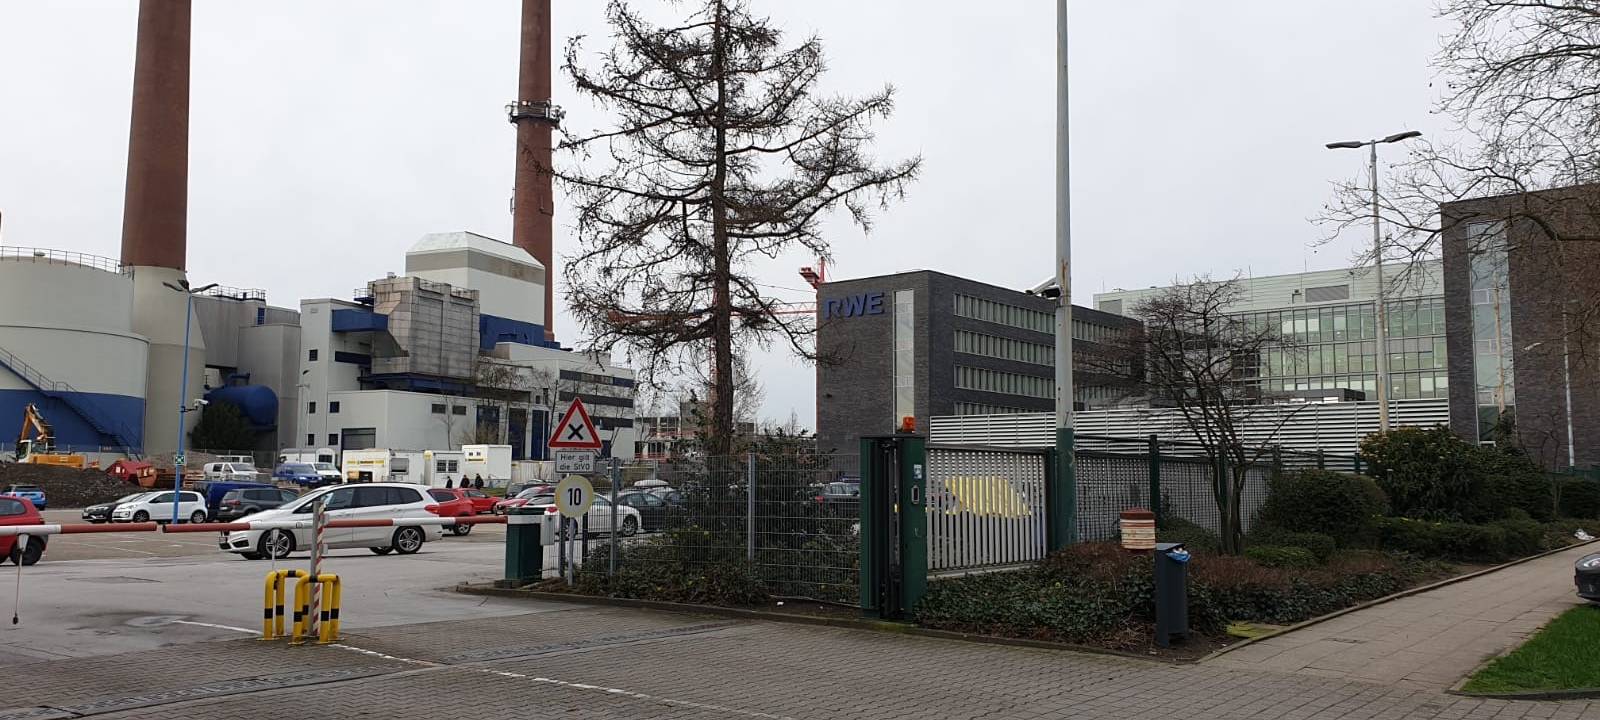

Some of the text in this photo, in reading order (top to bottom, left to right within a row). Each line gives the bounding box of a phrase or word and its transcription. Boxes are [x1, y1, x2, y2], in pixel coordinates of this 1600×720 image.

[823, 291, 885, 320] RWE
[560, 453, 590, 463] Hier gilt
[559, 462, 571, 470] die
[568, 487, 581, 506] 10
